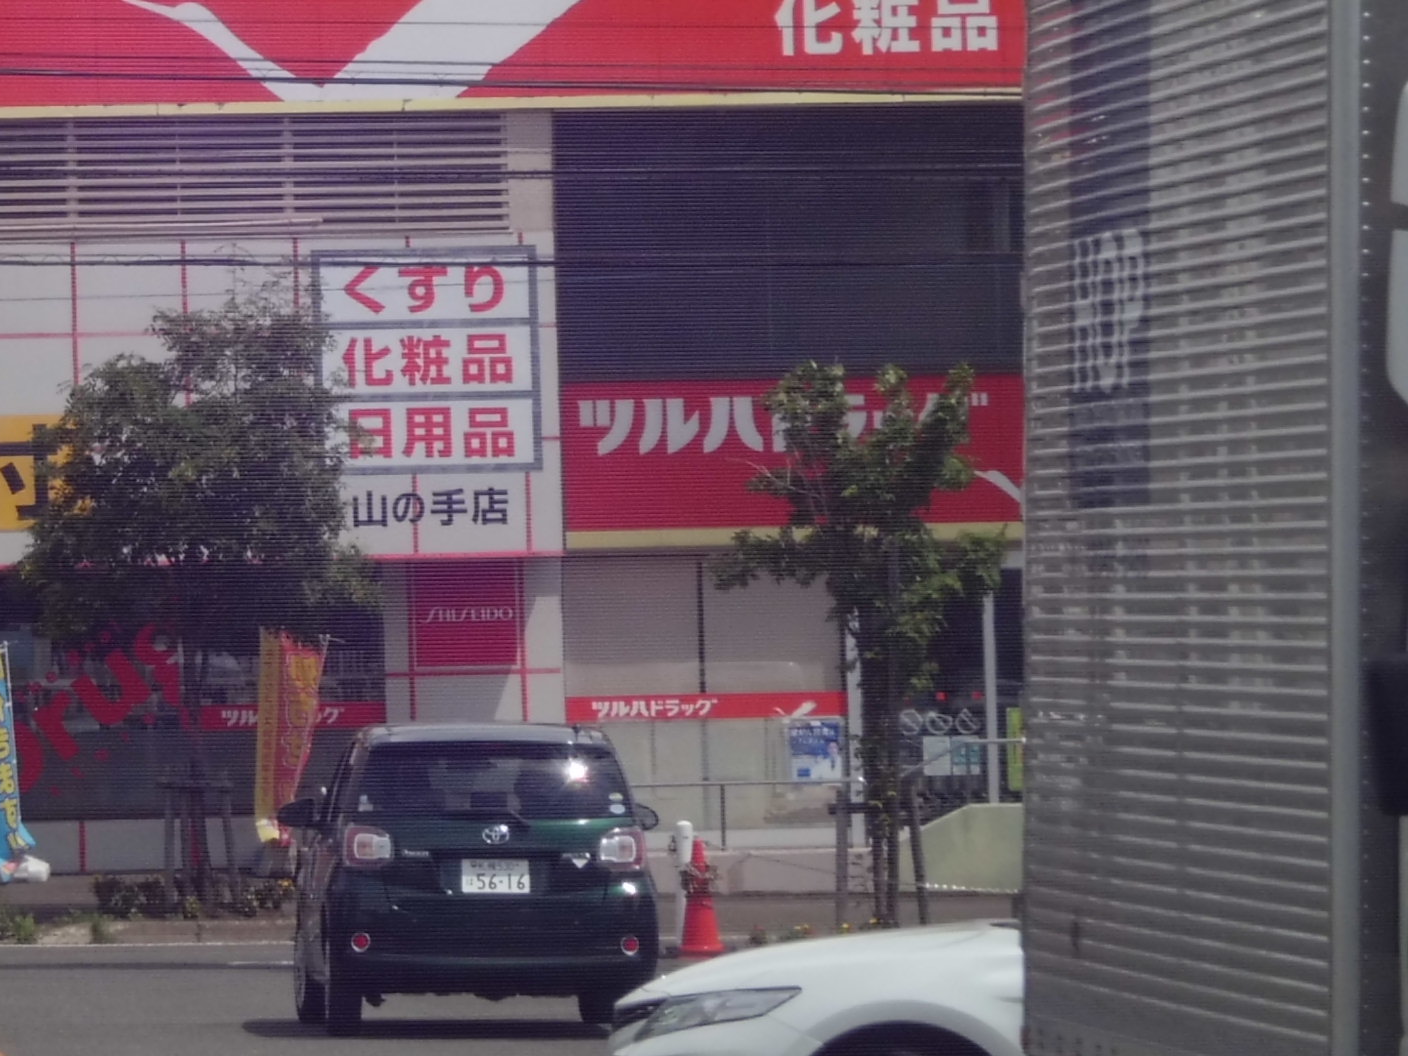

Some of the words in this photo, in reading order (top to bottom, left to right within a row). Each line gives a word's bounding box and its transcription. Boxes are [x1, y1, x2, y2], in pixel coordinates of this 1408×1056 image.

[344, 264, 505, 314] くすり
[342, 333, 514, 388] 化粧品
[348, 407, 515, 459] 日用品
[352, 487, 509, 528] 山の手店
[591, 698, 718, 717] ツルハドラッグ
